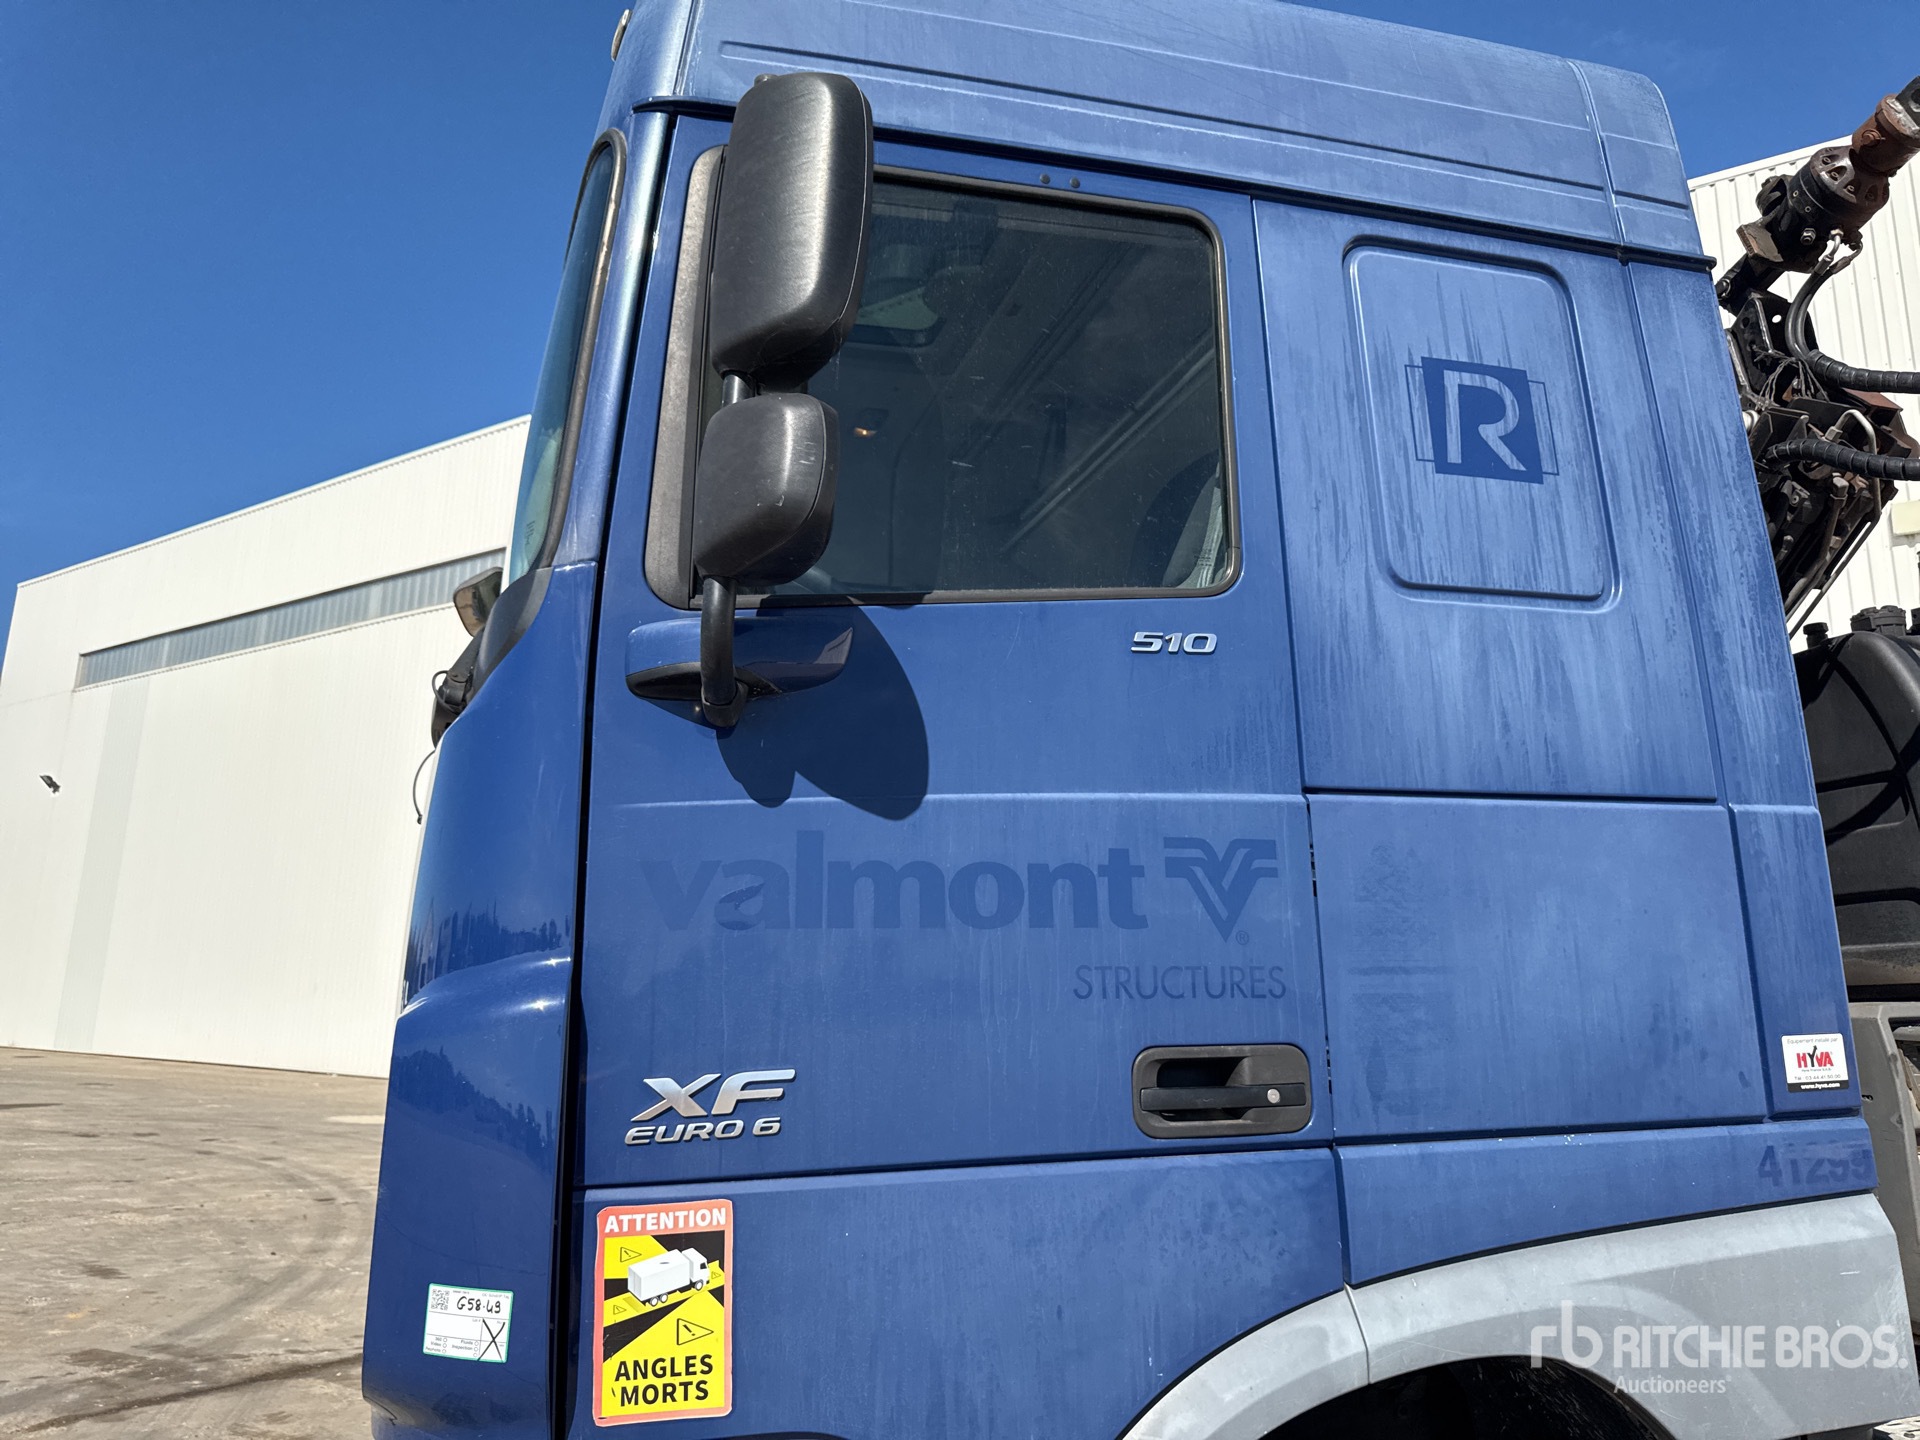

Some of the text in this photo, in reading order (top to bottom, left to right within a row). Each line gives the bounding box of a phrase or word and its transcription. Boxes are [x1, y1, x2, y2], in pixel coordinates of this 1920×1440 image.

[1130, 631, 1218, 654] 510
[641, 830, 1147, 931] valmont
[1073, 964, 1287, 1001] STRUCTURES
[1796, 1045, 1834, 1068] HYVA
[631, 1068, 796, 1122] XF
[624, 1116, 781, 1146] EURO 6
[604, 1207, 727, 1233] ATTENTION
[615, 1354, 714, 1382] ANGLES
[620, 1380, 709, 1407] MORTS
